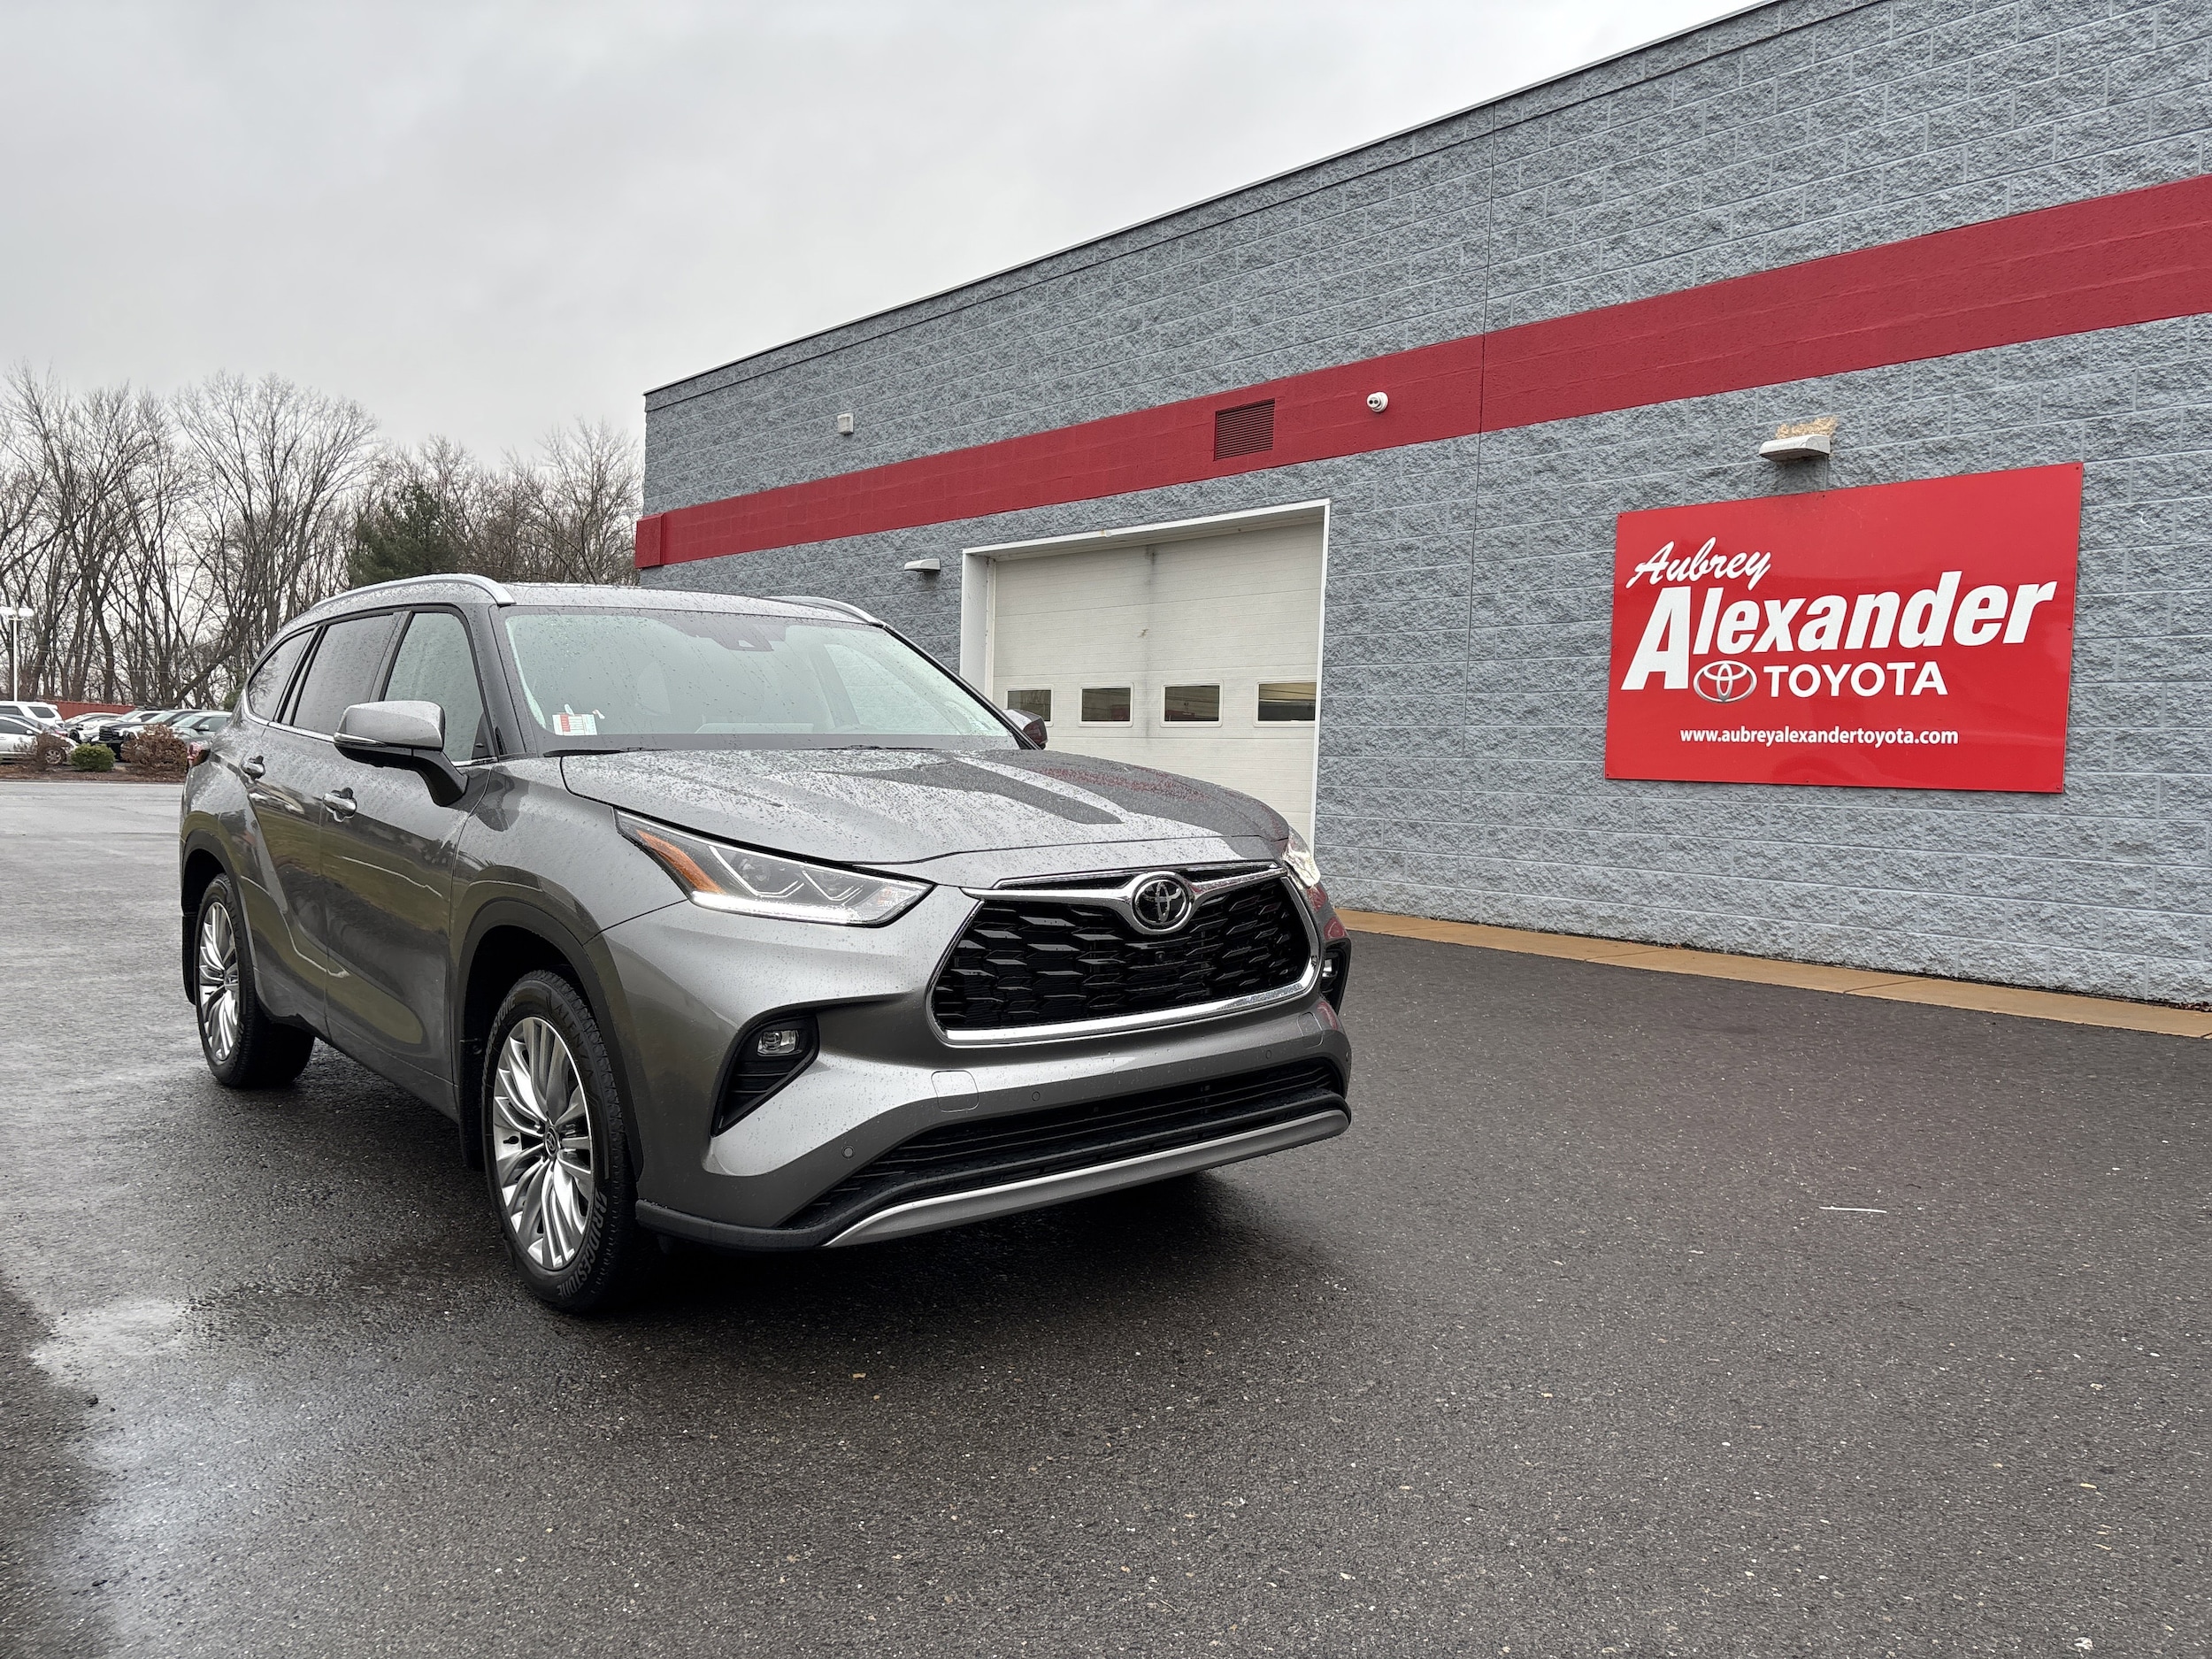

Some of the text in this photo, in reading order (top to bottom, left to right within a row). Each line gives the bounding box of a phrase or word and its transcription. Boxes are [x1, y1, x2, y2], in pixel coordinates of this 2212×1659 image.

[1625, 536, 1771, 591] Aubrey
[1620, 570, 2058, 691] Alexander
[1763, 661, 1948, 698] TOYOTA
[1679, 726, 1959, 749] www.aubreyalexandertoyota.com
[556, 1187, 609, 1299] BRIDGESTONE
